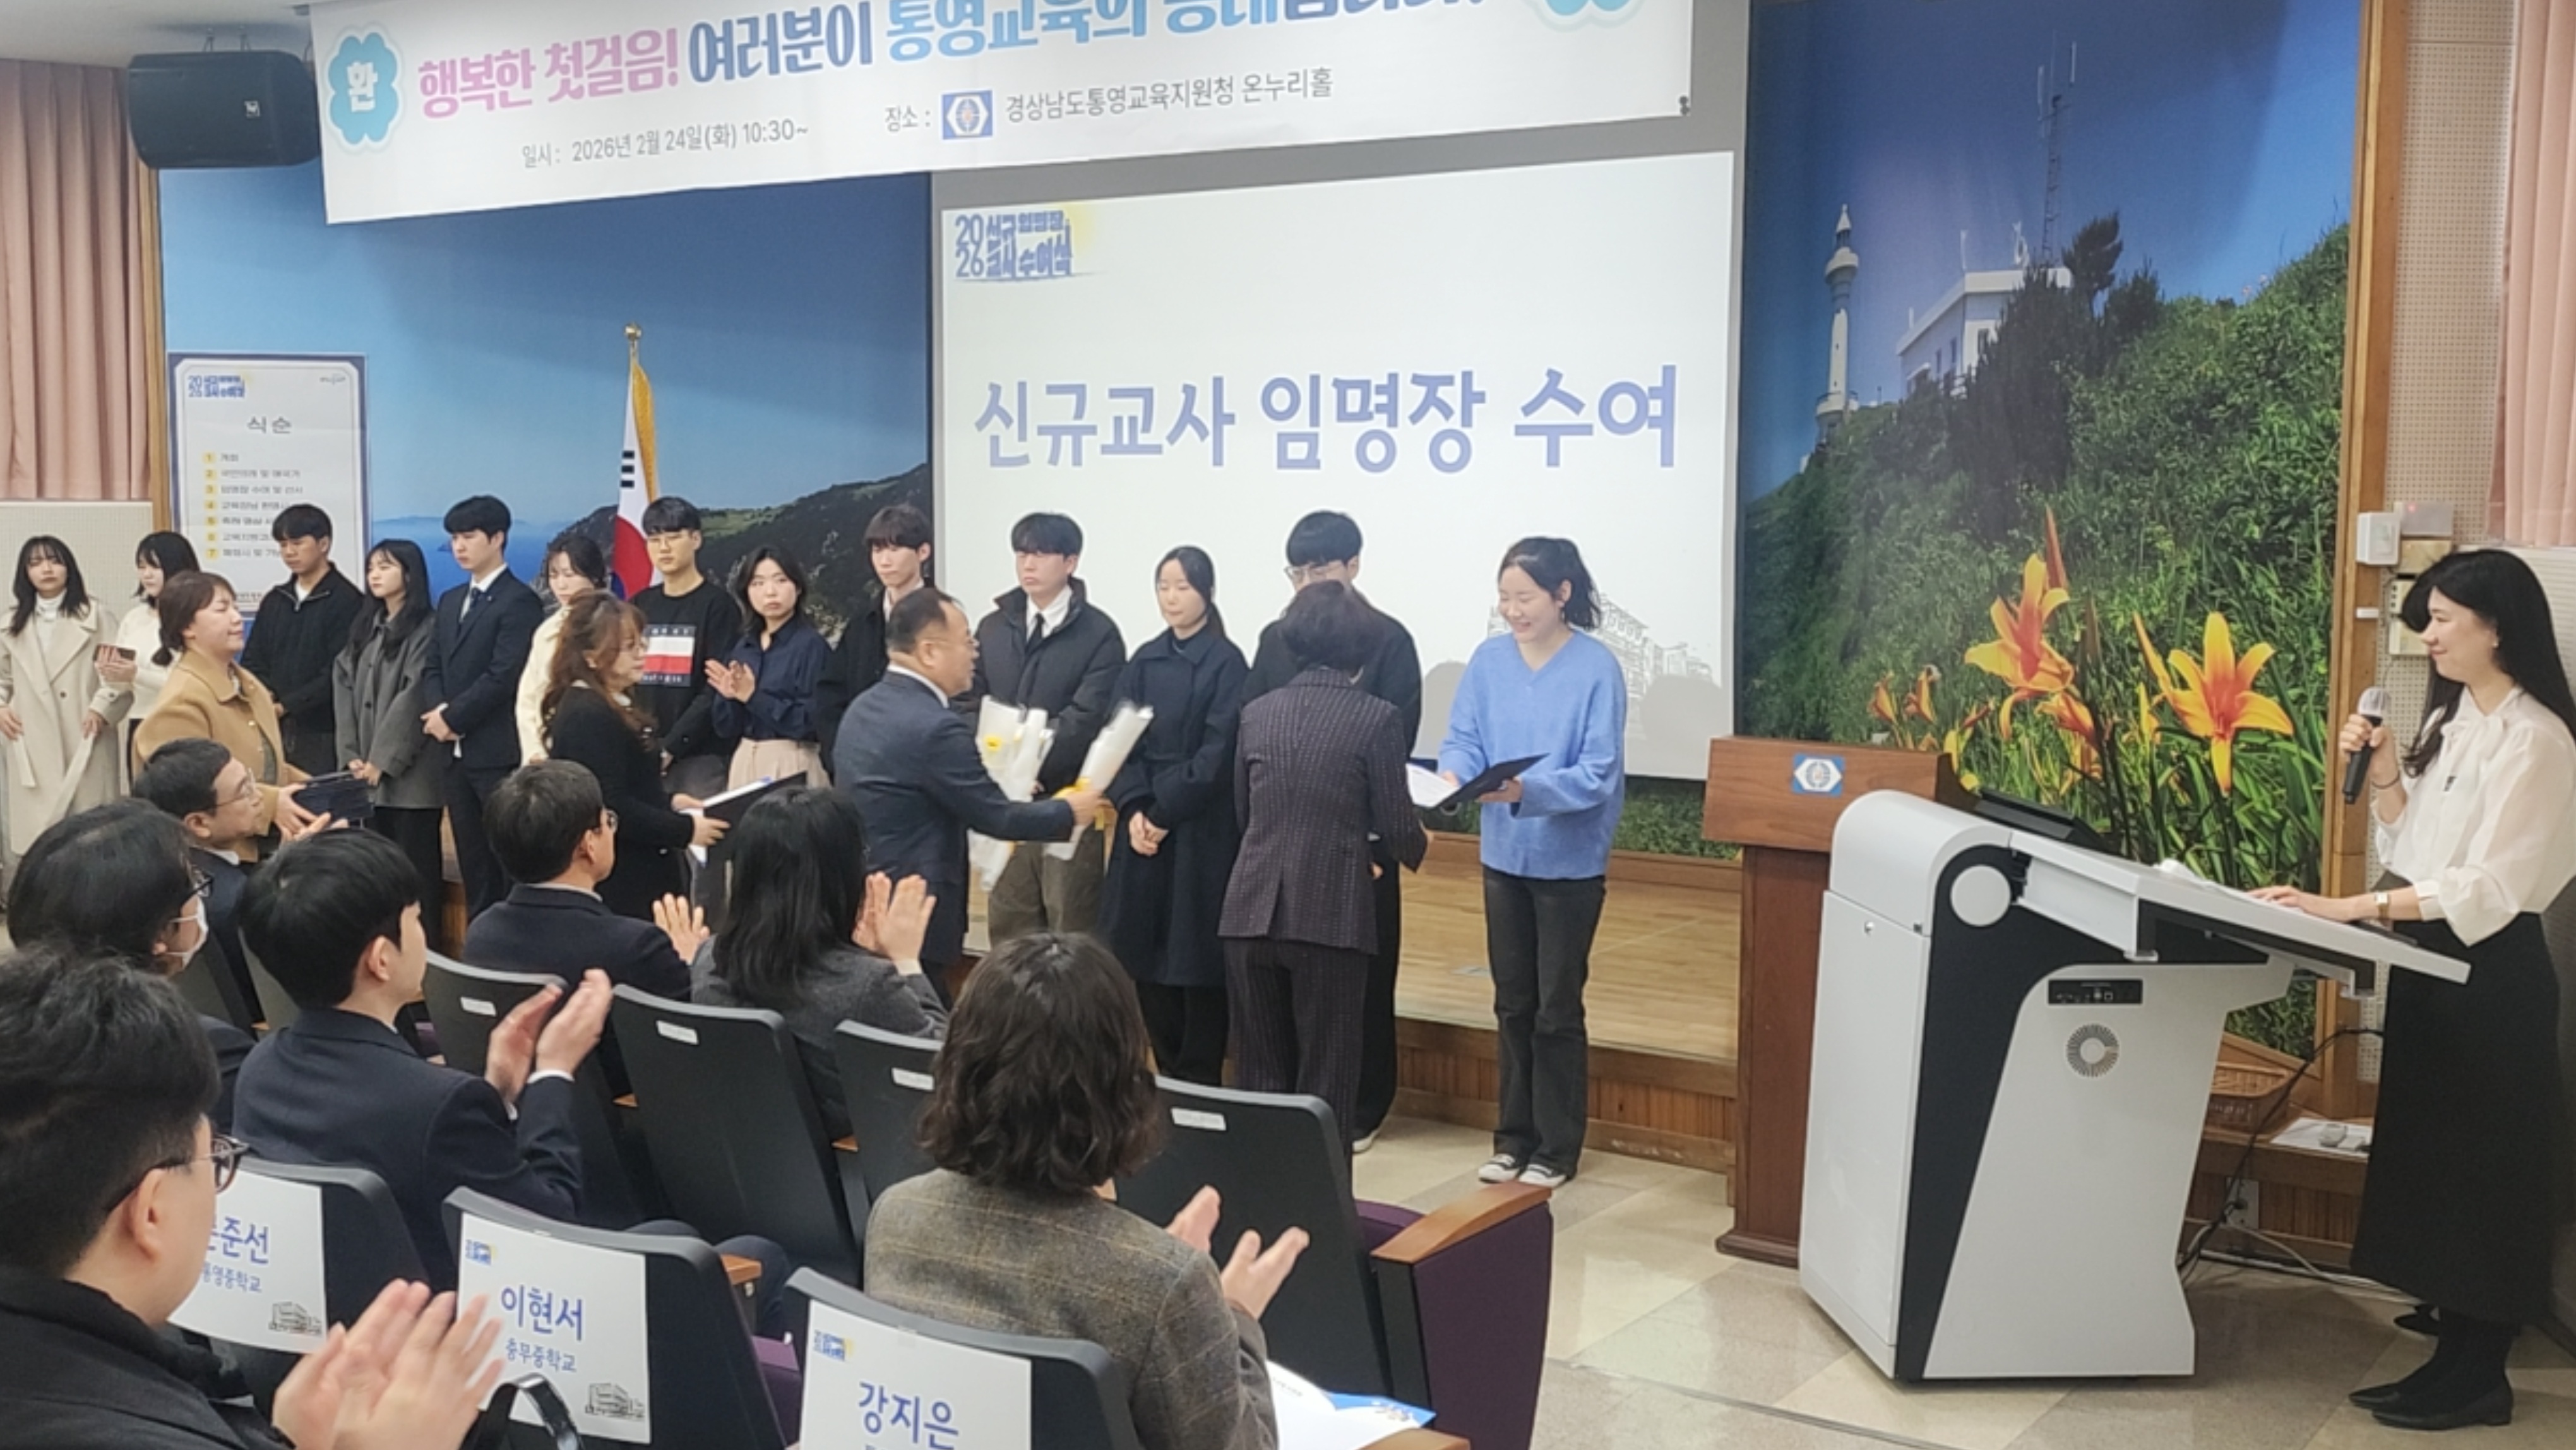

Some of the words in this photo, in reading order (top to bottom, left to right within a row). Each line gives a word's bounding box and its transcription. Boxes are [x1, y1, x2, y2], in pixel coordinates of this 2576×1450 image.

[347, 62, 378, 112] 환
[418, 49, 536, 118] 행복한
[544, 28, 679, 102] 첫걸음!
[689, 1, 873, 82] 여러분이
[1006, 75, 1234, 123] 경상남도통영교육지원청
[1241, 67, 1333, 104] 온누리홀
[572, 133, 631, 162] 2026년
[636, 130, 660, 155] 2월
[665, 123, 737, 152] 24일(화)
[742, 118, 809, 144] 10:30~
[974, 376, 1236, 467] 신규교사
[1260, 370, 1486, 474] 임명장
[1514, 364, 1677, 467] 수여
[501, 1285, 582, 1341] 이현서
[506, 1338, 576, 1373] 충무중학교
[859, 1381, 959, 1450] 강지은
